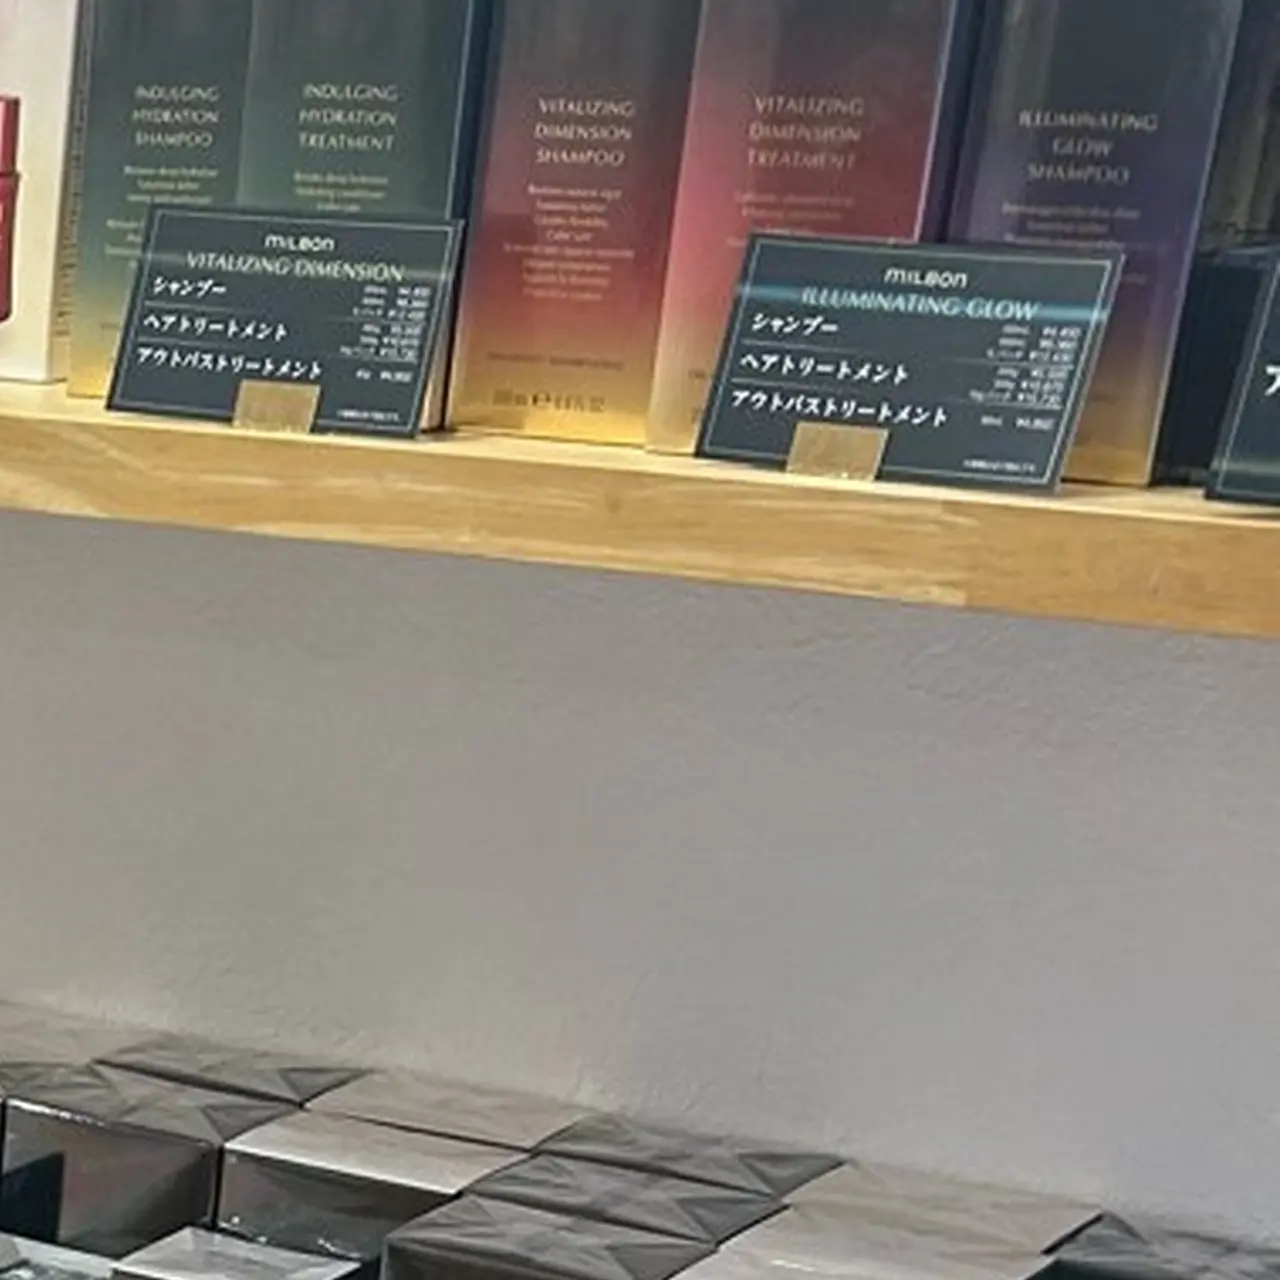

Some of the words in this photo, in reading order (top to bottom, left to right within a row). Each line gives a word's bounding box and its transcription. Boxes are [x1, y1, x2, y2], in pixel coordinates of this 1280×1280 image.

[152, 276, 228, 298] シャンプー
[143, 314, 289, 343] ヘアトリートメント
[751, 312, 839, 334] シャンプー
[137, 345, 323, 381] アウトバストリートメント
[740, 354, 909, 384] ヘアトリートメント
[730, 389, 948, 427] アウトバストリートメント
